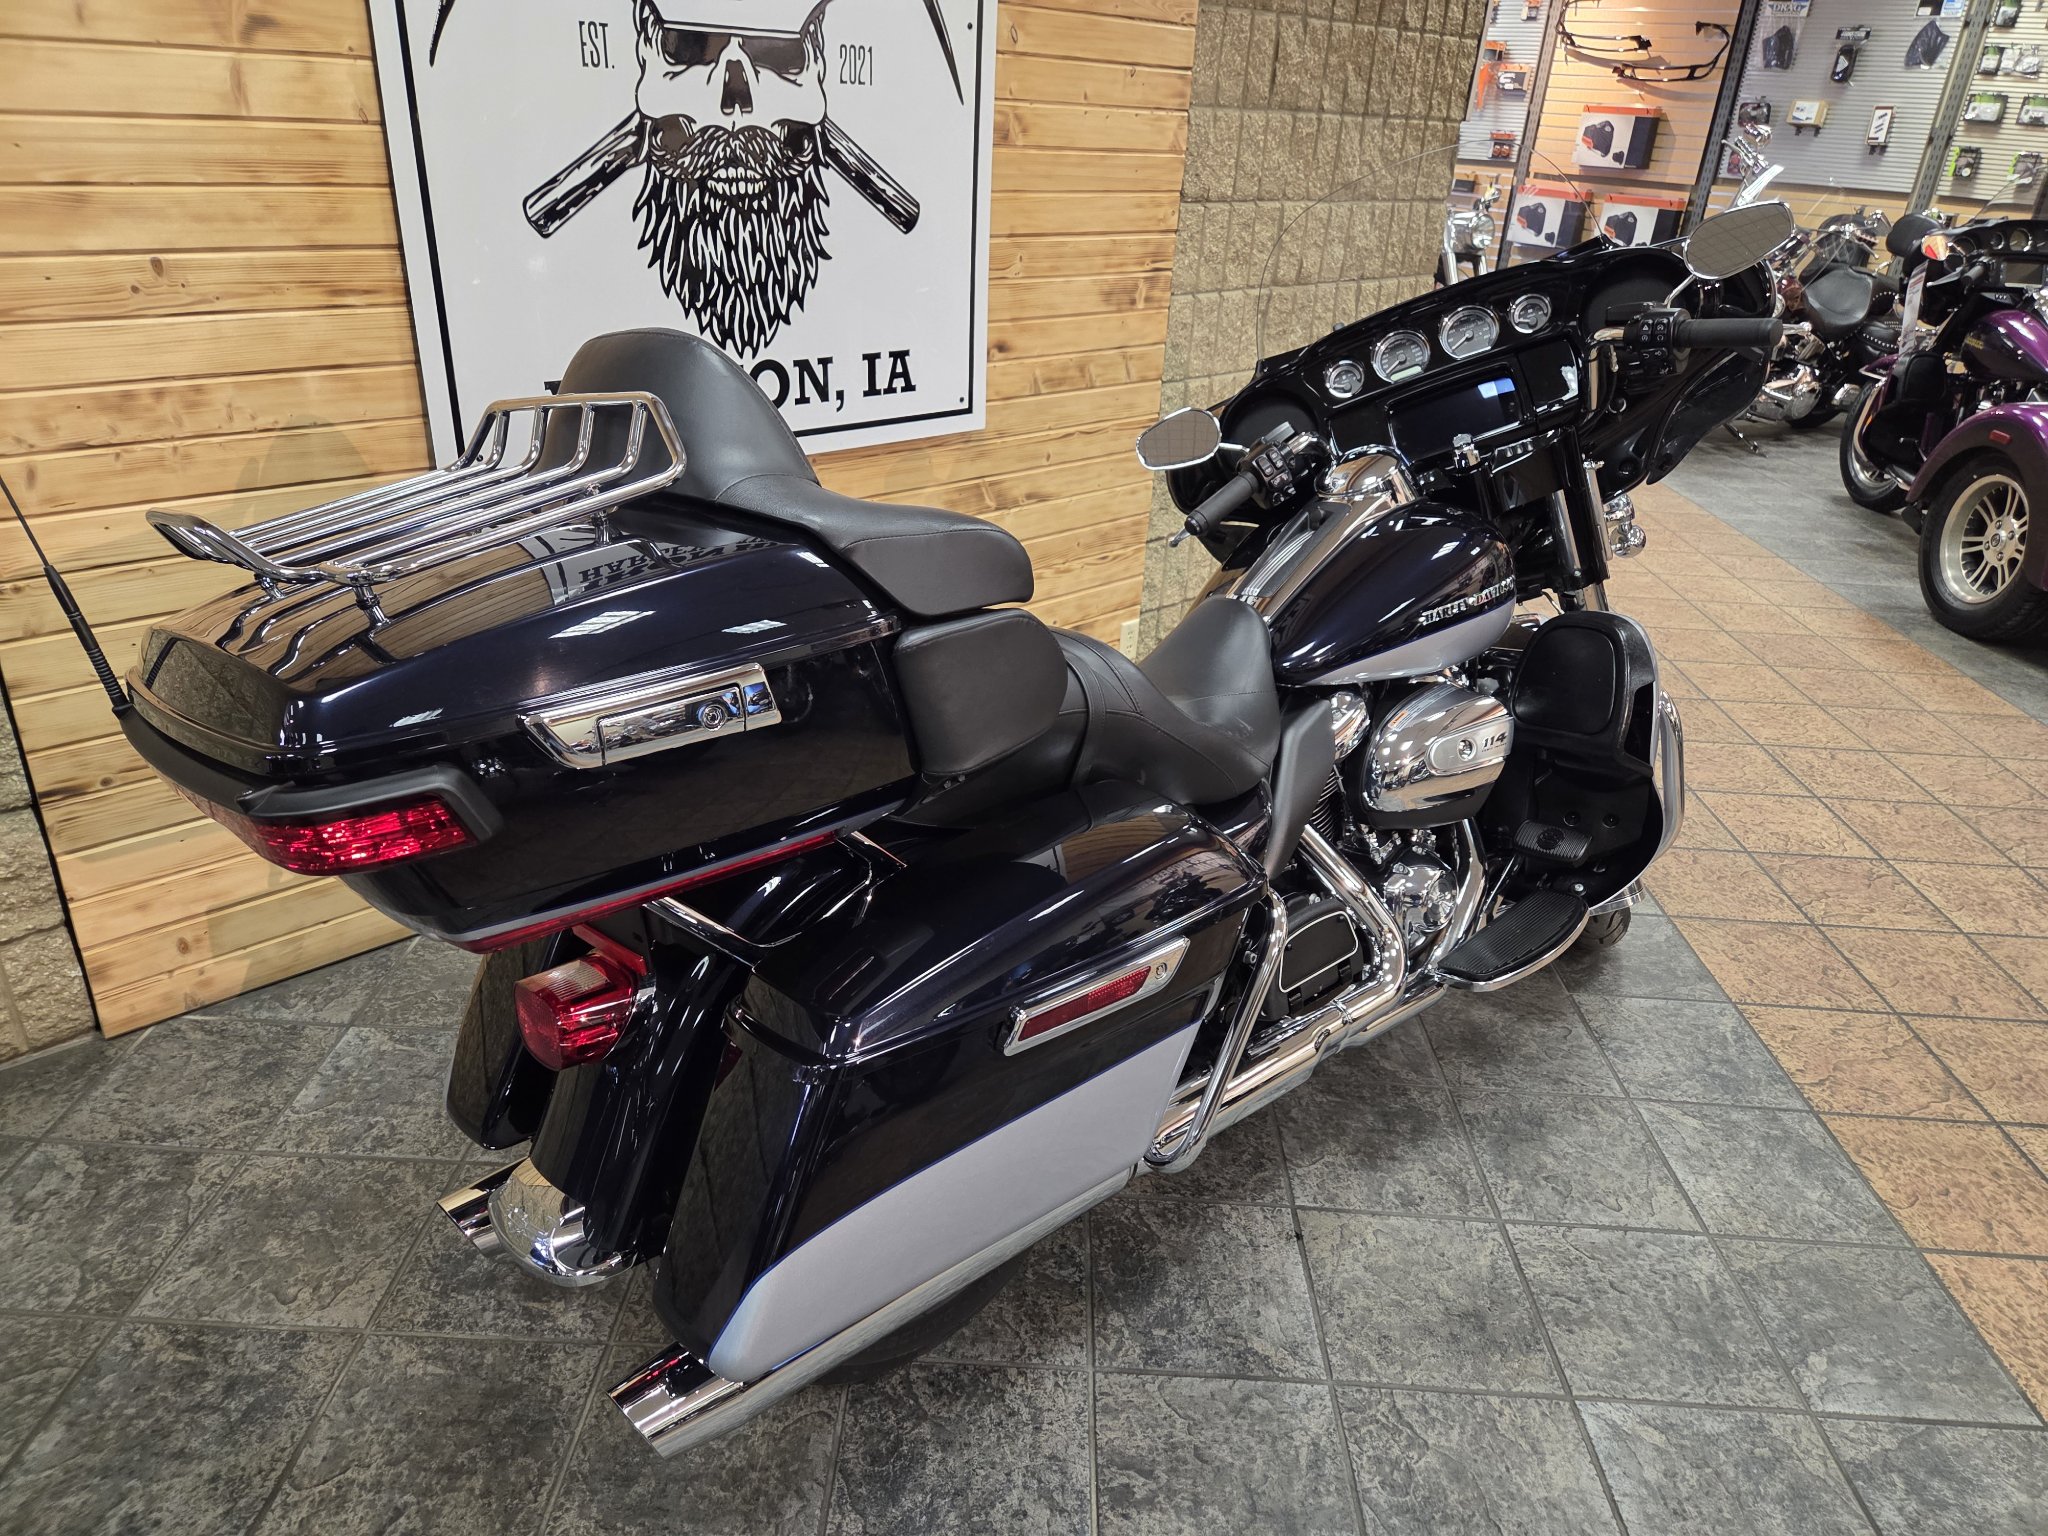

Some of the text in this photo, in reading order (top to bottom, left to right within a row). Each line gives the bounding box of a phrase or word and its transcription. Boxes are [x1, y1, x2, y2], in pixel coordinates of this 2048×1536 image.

[579, 21, 615, 69] EST.
[840, 44, 872, 86] 2021
[862, 349, 917, 398] IA
[1483, 731, 1507, 748] 114
